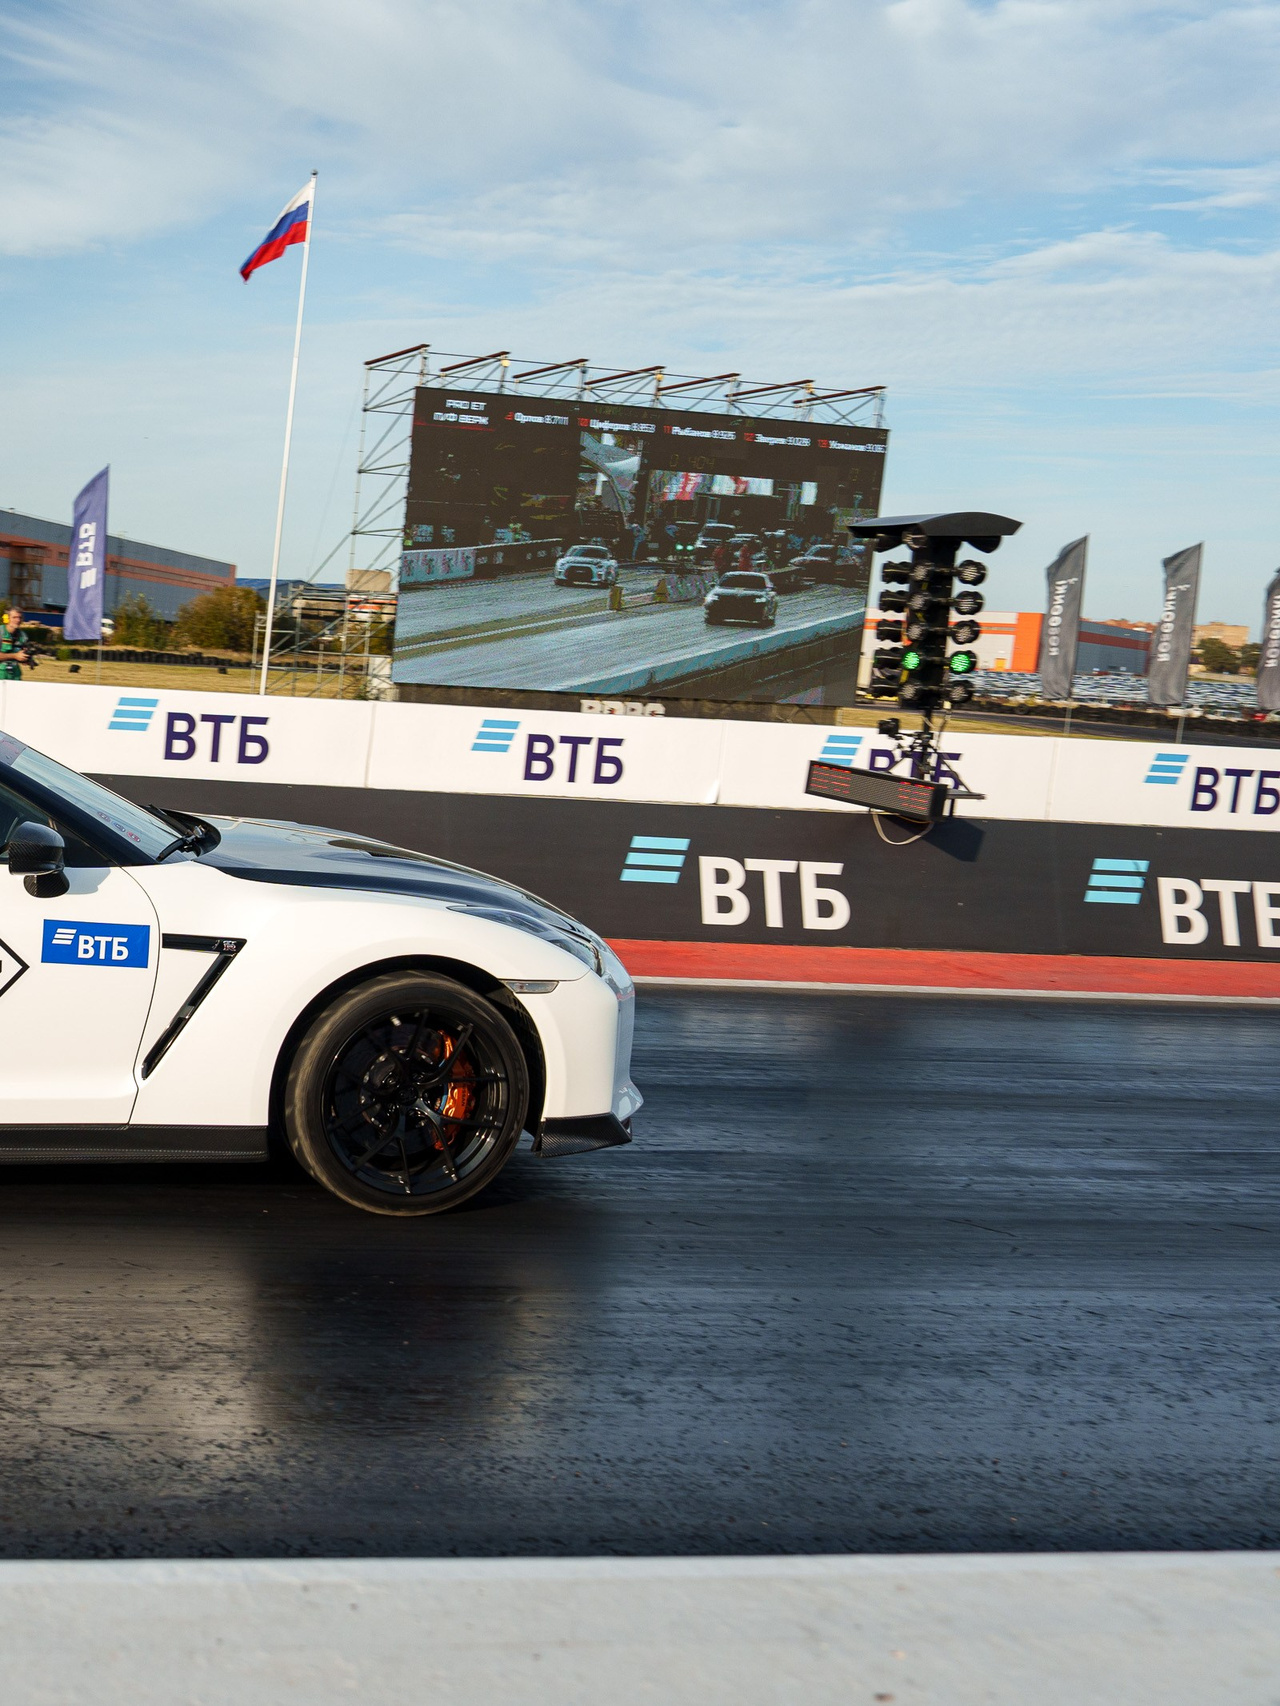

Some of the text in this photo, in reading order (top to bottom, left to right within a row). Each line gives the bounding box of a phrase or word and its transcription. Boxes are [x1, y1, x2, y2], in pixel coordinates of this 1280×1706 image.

[163, 711, 270, 765] ВТБ
[523, 733, 625, 785] ВТБ
[1189, 766, 1280, 815] ВТБ
[698, 855, 851, 930] ВТБ
[77, 934, 129, 961] ВТБ
